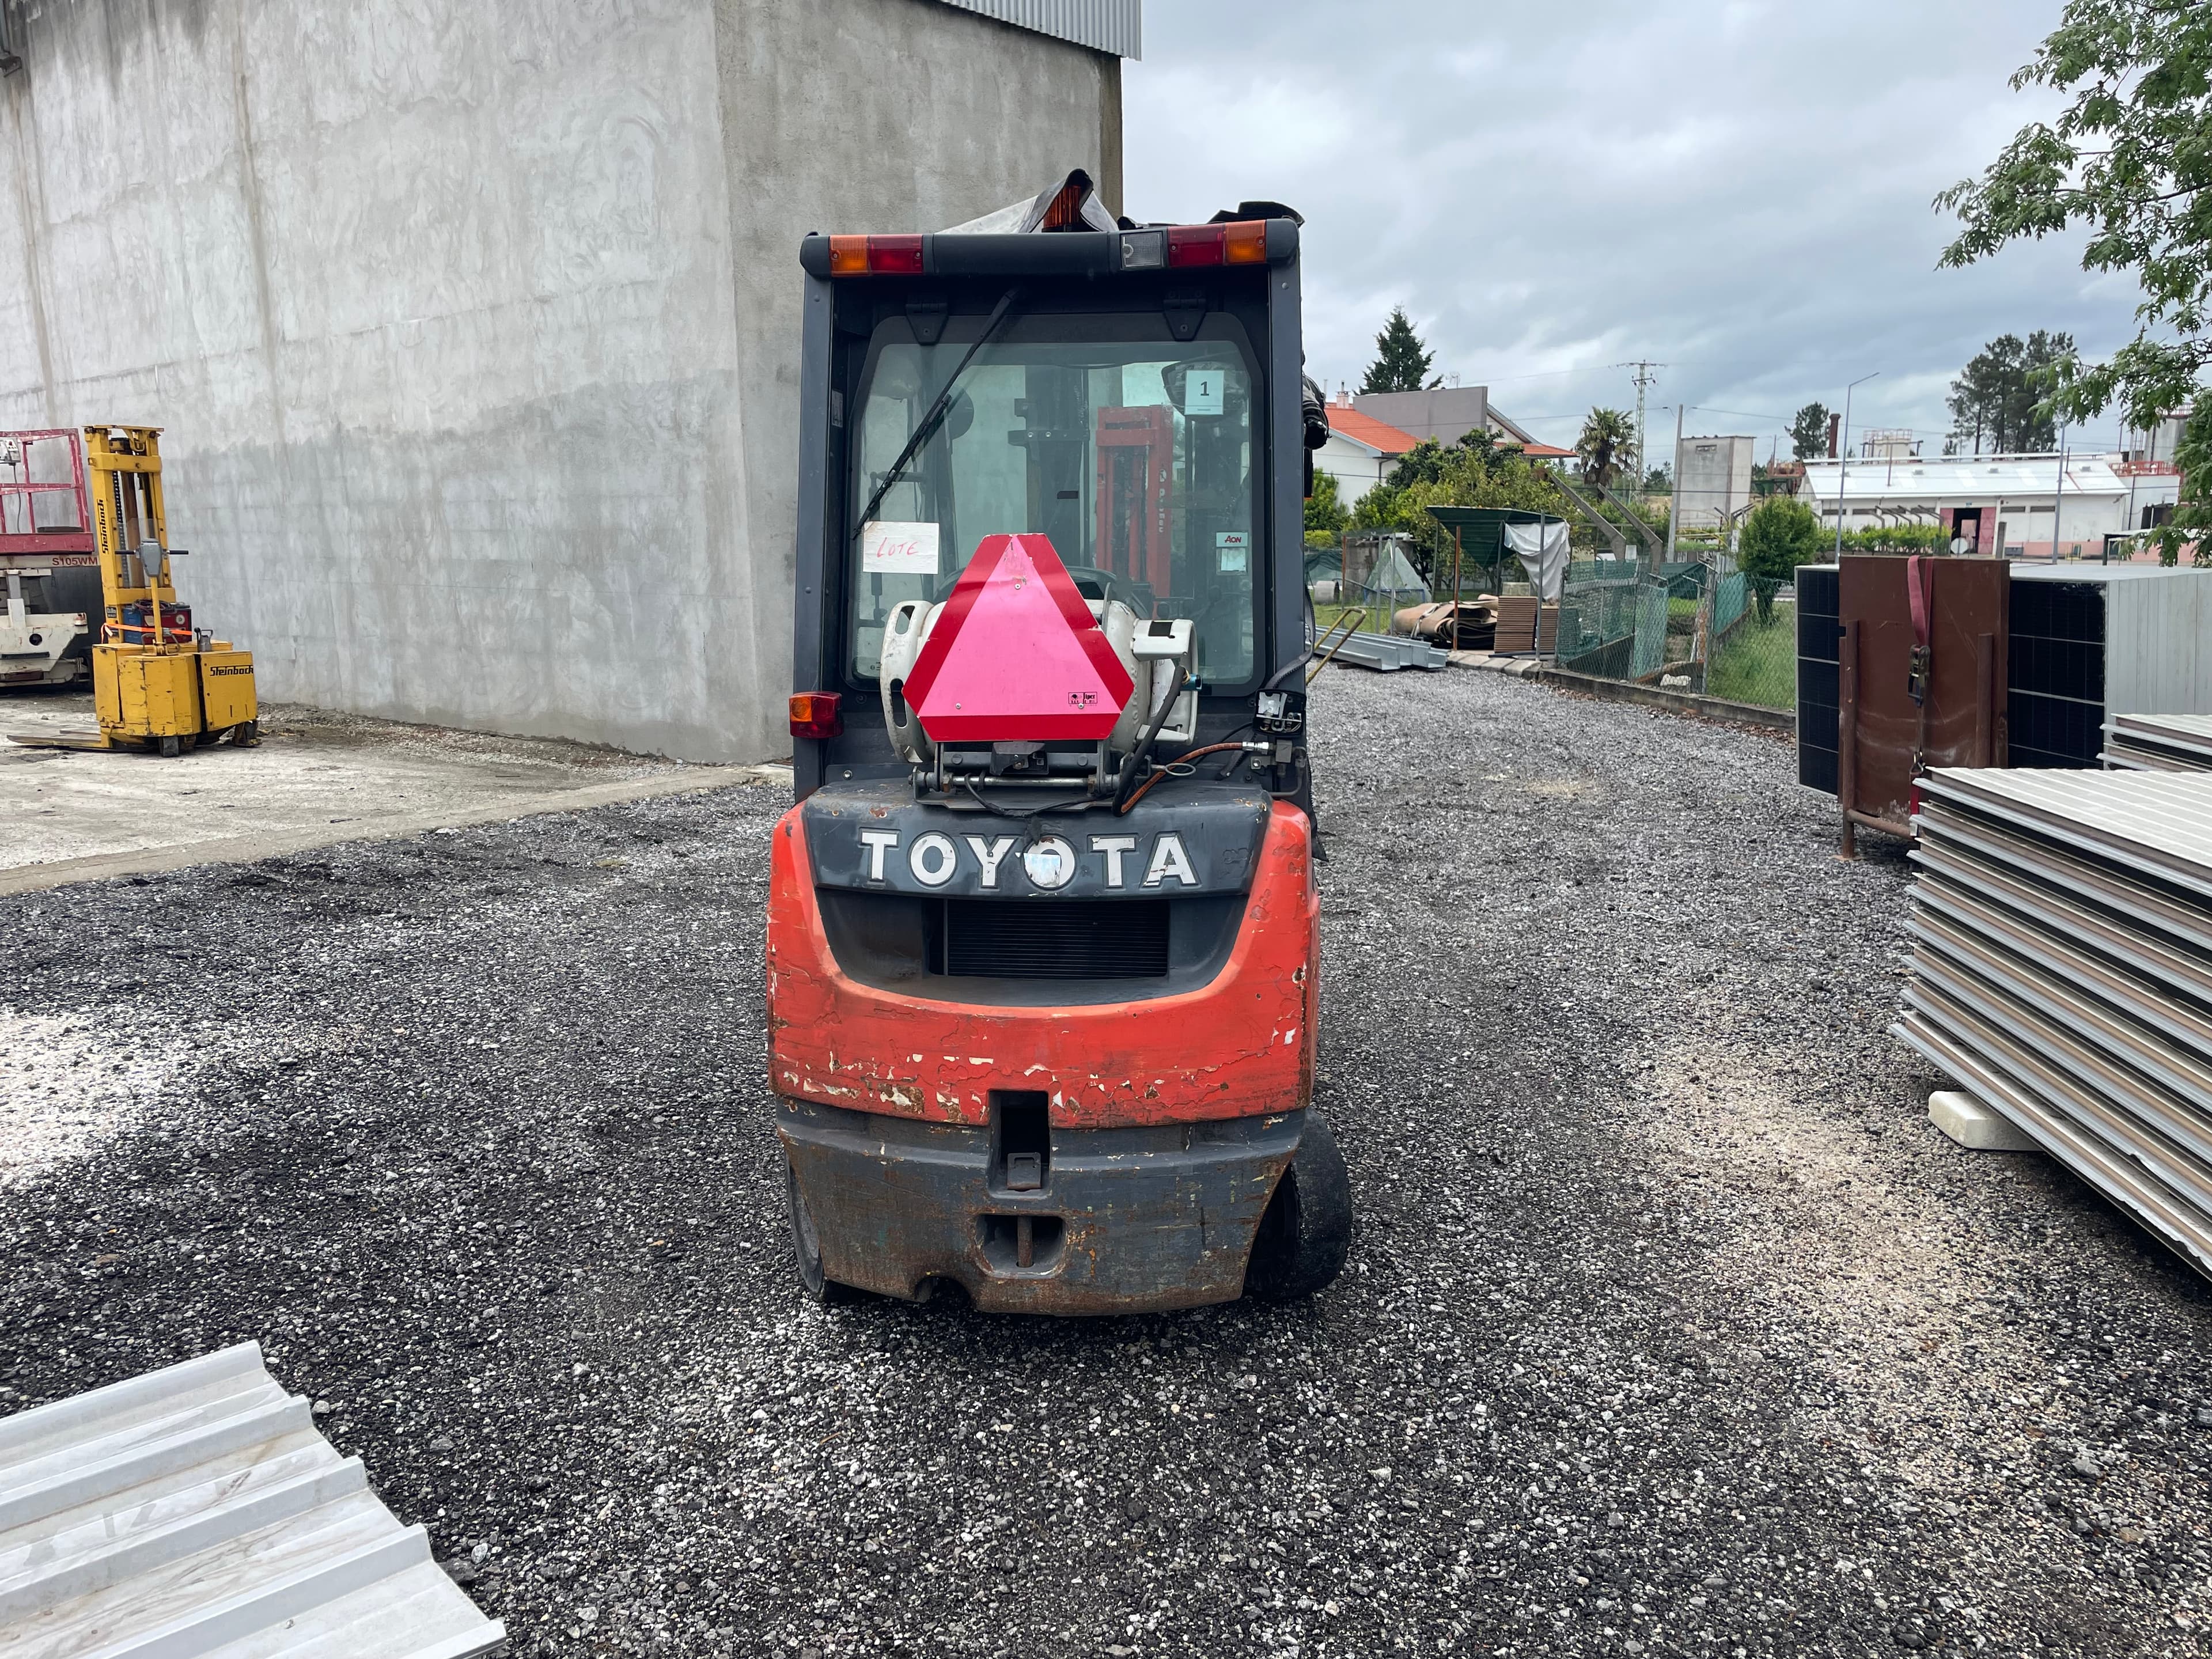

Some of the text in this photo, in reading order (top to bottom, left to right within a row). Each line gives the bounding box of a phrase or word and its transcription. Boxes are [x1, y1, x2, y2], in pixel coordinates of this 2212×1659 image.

[1200, 381, 1210, 396] 1
[97, 498, 109, 554] Steinbock
[877, 536, 919, 558] LOTE
[52, 556, 98, 566] S105WM
[210, 664, 253, 676] Steinbock
[861, 832, 1199, 889] TOYOTA
